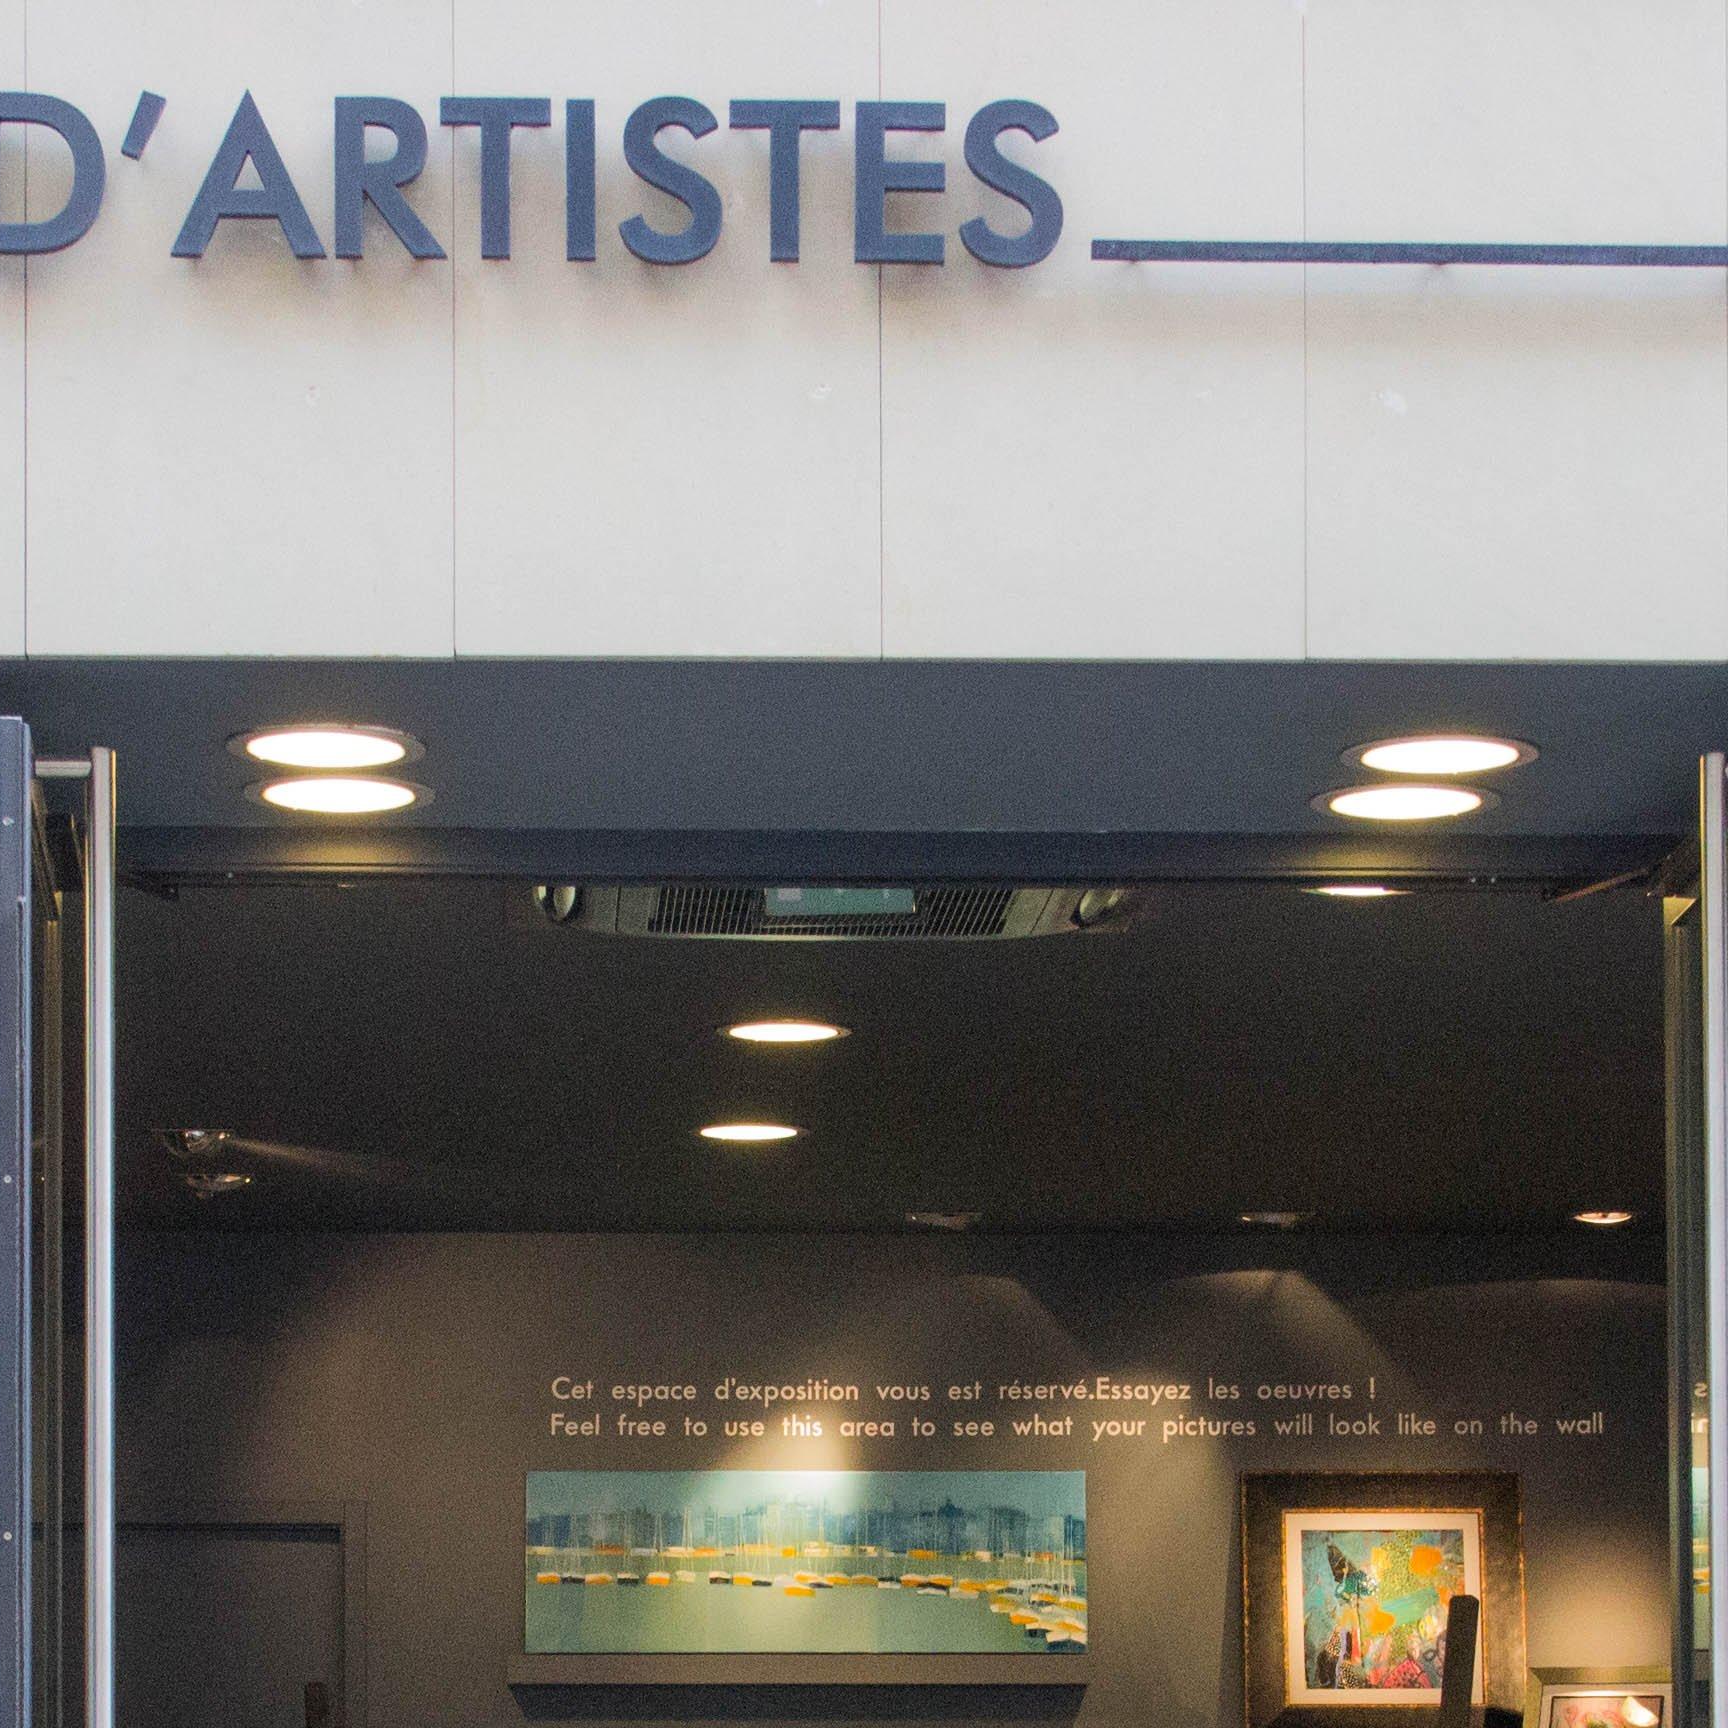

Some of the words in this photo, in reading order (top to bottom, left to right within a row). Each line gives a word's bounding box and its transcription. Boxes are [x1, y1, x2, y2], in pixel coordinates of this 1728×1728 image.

[551, 1377, 594, 1401] Cet
[611, 1382, 697, 1408] espace
[714, 1377, 860, 1407] d'exposition
[876, 1383, 931, 1401] vous
[947, 1381, 982, 1401] est
[1208, 1379, 1240, 1399] les
[1257, 1382, 1352, 1400] oeuvres
[550, 1413, 600, 1437] Feel
[617, 1413, 666, 1437] free
[683, 1416, 707, 1437] to
[724, 1420, 765, 1437] use
[781, 1414, 823, 1437] this
[839, 1420, 895, 1437] area
[911, 1416, 936, 1437] to
[953, 1420, 995, 1437] see
[1012, 1414, 1073, 1437] what
[1091, 1418, 1146, 1442] your
[1162, 1414, 1256, 1443] pictures
[1274, 1414, 1313, 1436] will
[1329, 1413, 1381, 1436] look
[1398, 1413, 1437, 1436] like
[1454, 1418, 1483, 1435] on
[1500, 1413, 1539, 1436] the
[1556, 1412, 1604, 1435] wall
